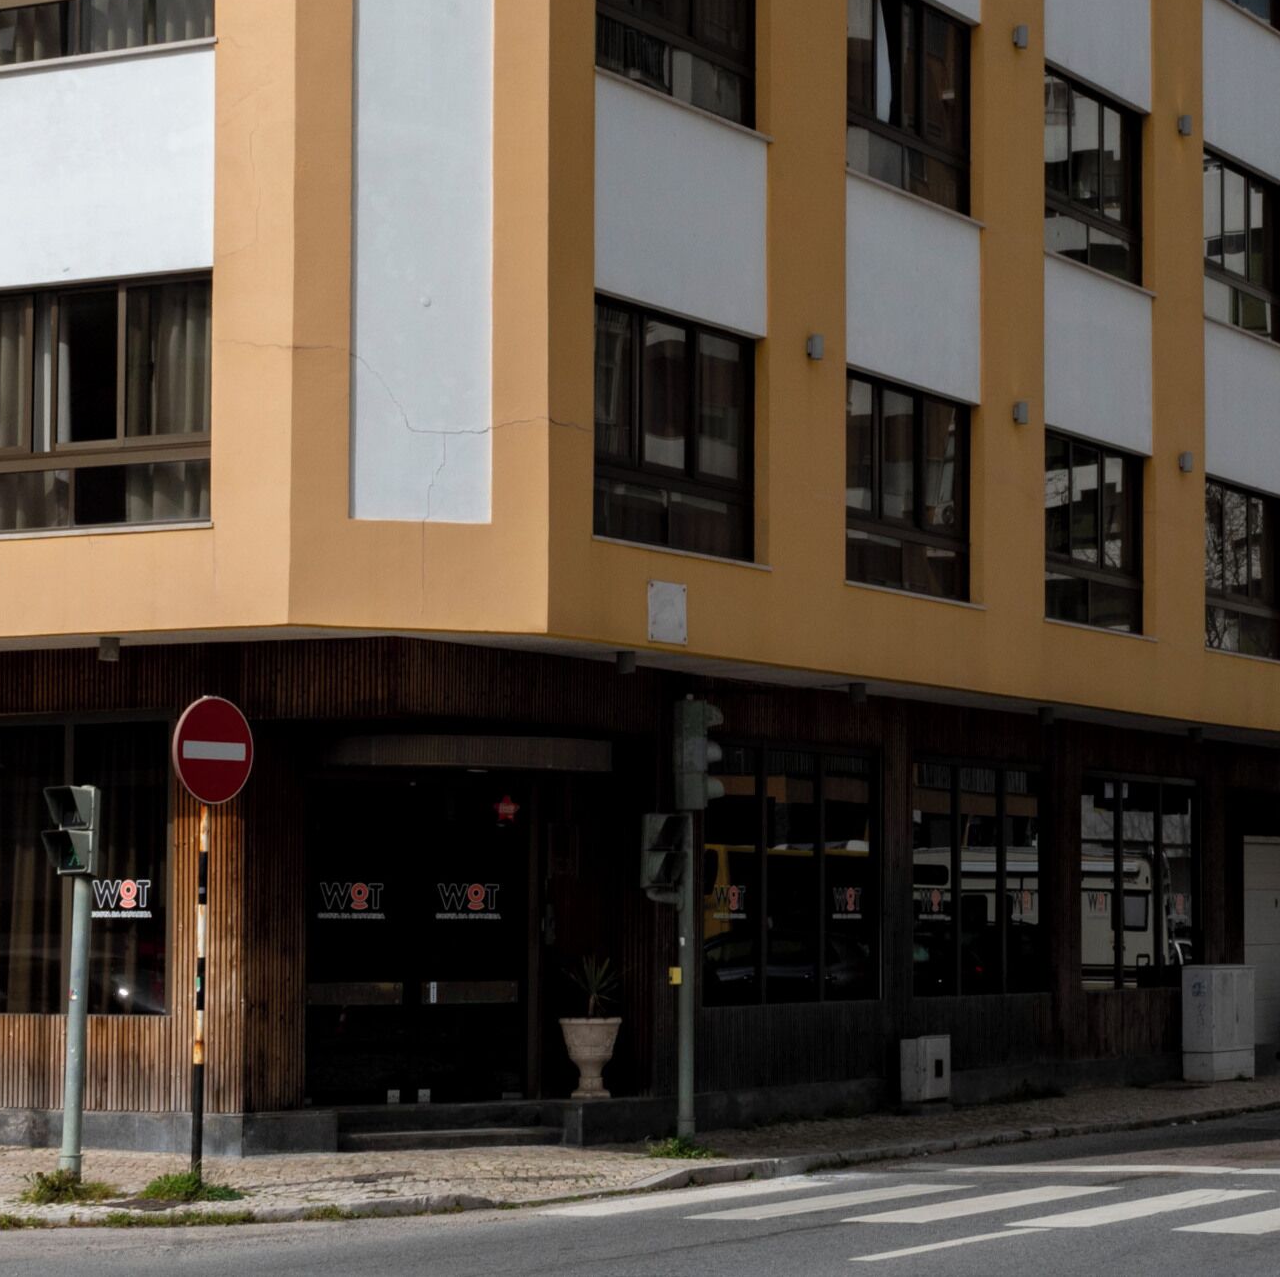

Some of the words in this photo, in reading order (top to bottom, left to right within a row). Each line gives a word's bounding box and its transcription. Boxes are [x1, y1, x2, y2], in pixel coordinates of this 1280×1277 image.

[92, 879, 151, 909] WOT
[320, 882, 384, 910] WOT
[437, 883, 500, 910] WOT
